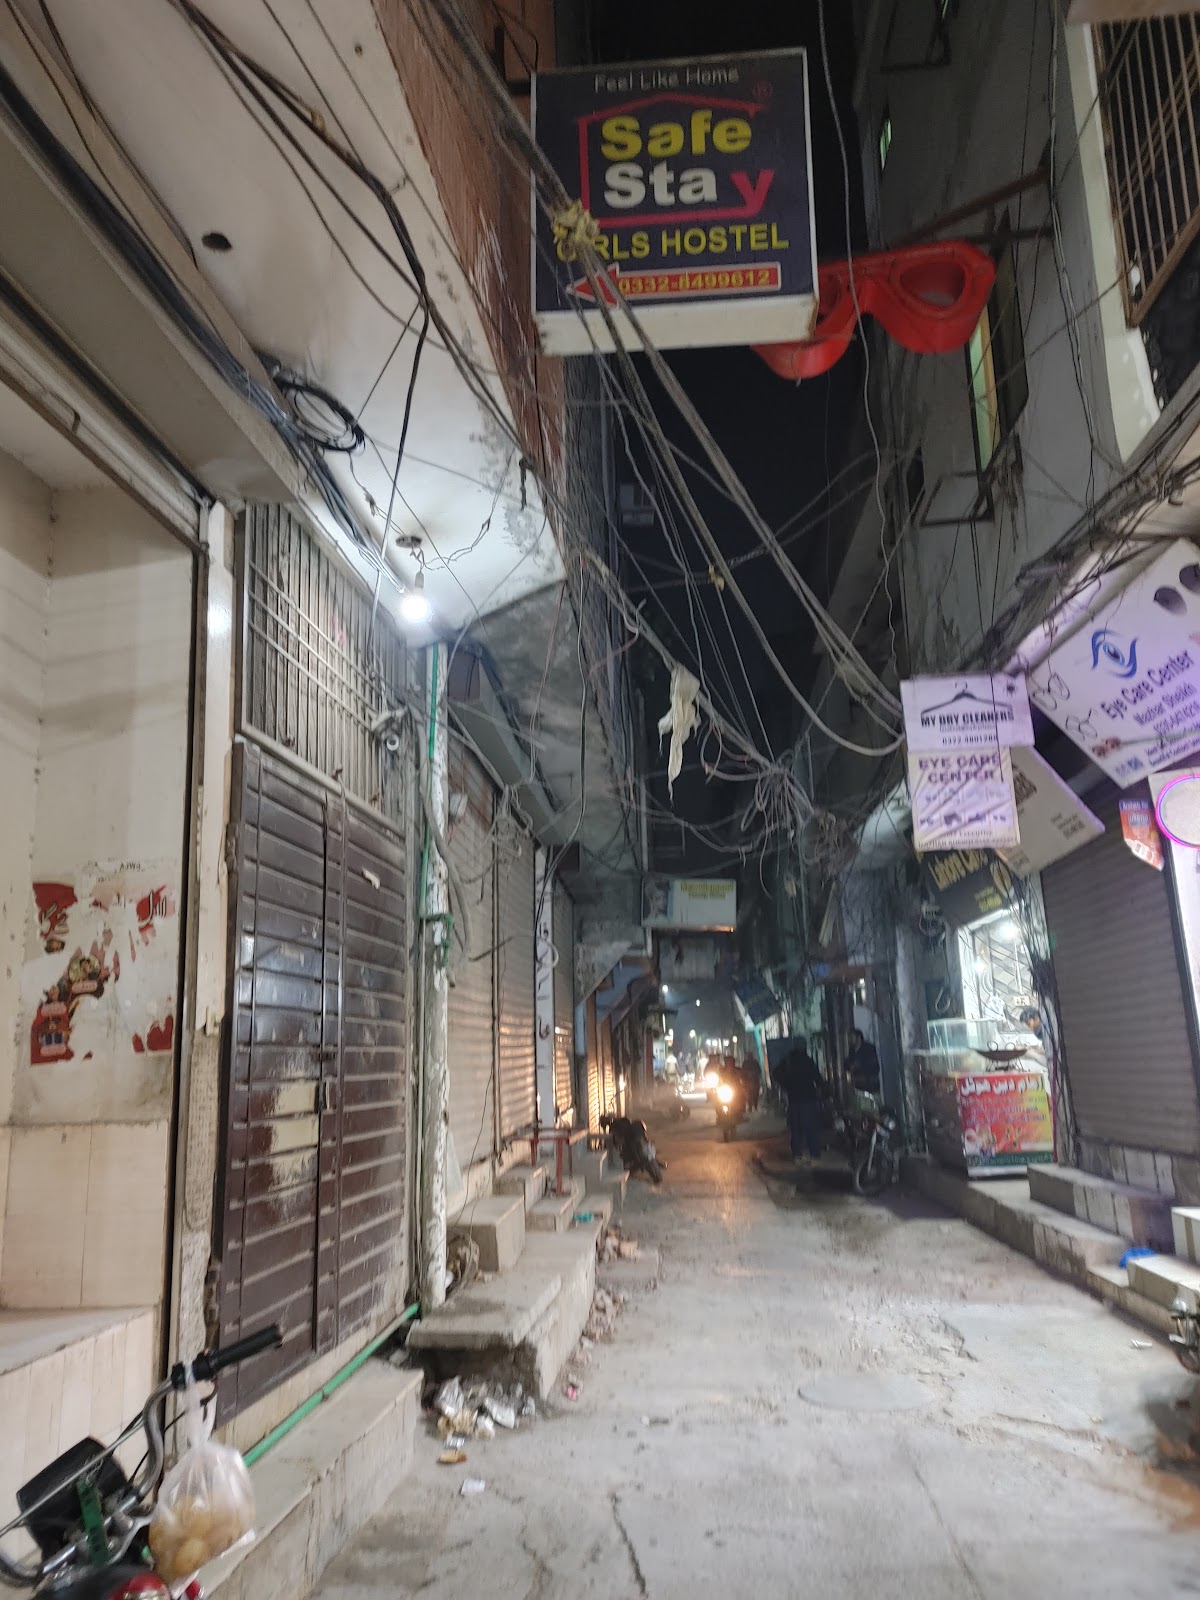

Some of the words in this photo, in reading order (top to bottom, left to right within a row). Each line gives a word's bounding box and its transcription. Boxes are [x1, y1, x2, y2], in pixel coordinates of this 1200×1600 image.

[594, 75, 632, 93] Feel
[640, 70, 679, 89] Like
[686, 66, 740, 86] Home
[601, 109, 752, 161] Safe
[603, 161, 775, 217] Stay
[661, 223, 789, 256] HOSTEL
[1101, 699, 1128, 719] Eye
[1121, 681, 1154, 705] Care
[1147, 650, 1194, 686] Center
[921, 713, 936, 728] MY
[919, 756, 951, 769] EYE
[957, 752, 1000, 769] CARE
